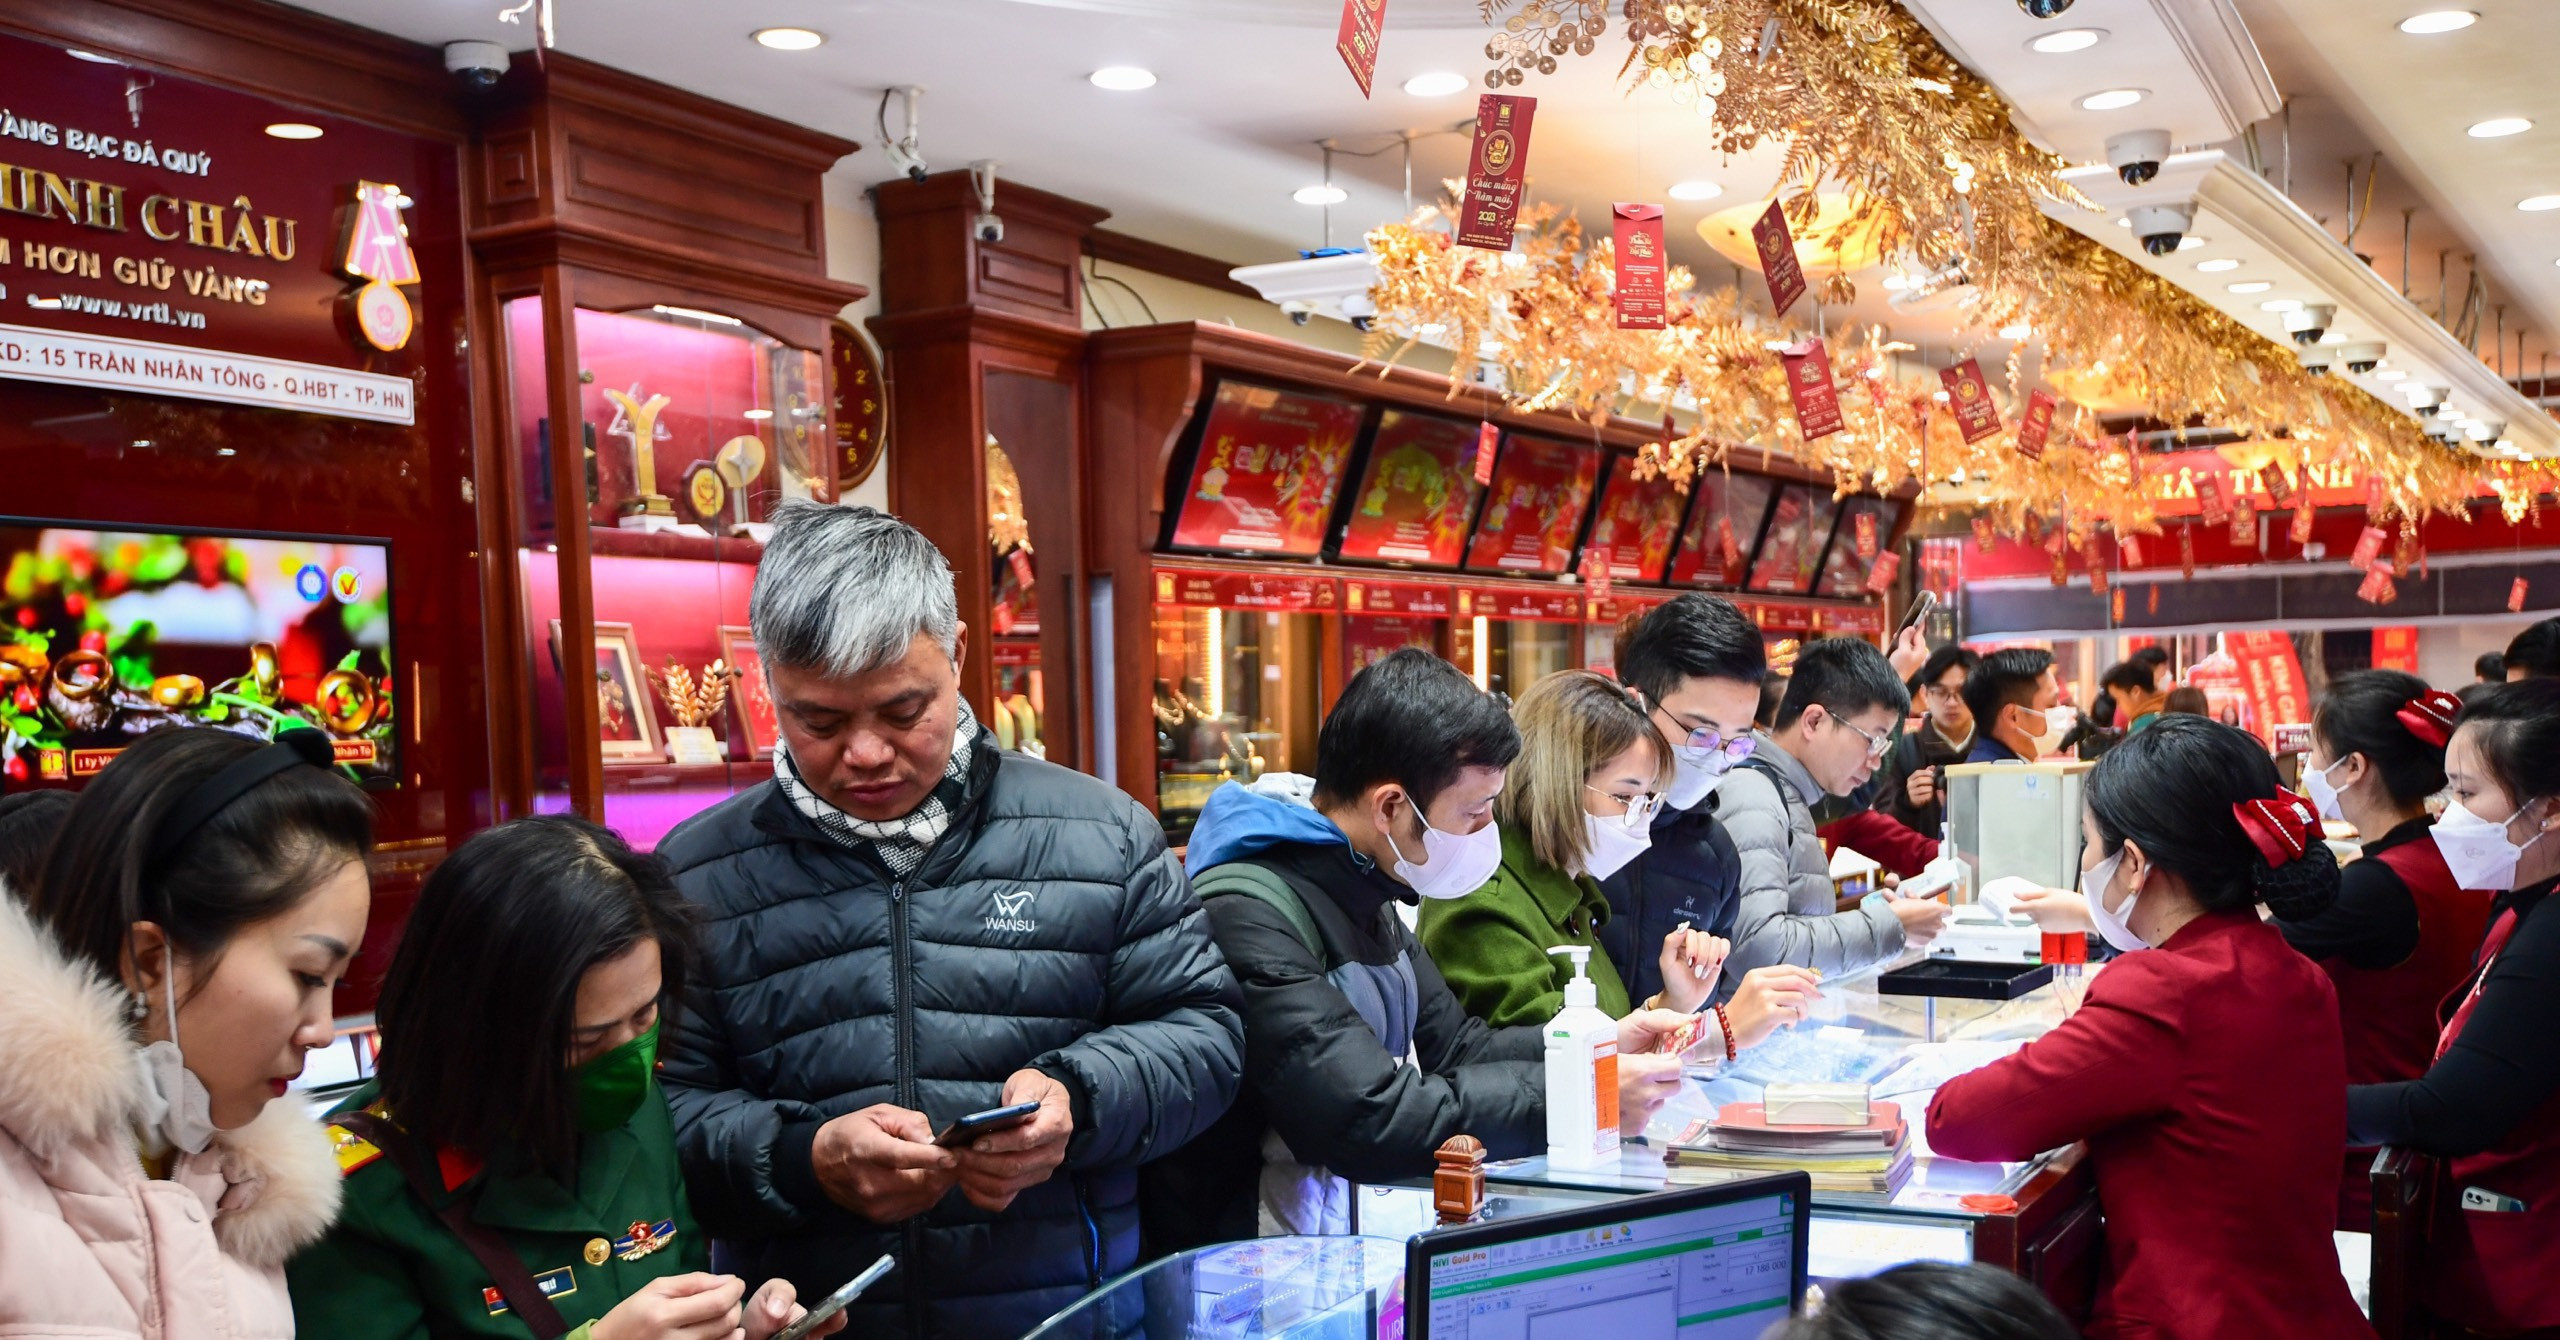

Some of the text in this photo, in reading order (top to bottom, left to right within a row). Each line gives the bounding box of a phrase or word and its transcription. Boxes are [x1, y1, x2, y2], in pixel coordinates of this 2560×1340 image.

[66, 128, 119, 159] BẠC
[123, 139, 160, 167] ĐÁ
[162, 149, 211, 177] QUÝ
[140, 192, 298, 262] CHÂU
[24, 241, 101, 279] HƠN
[113, 257, 175, 290] GIỮ
[183, 265, 270, 306] VÀNG
[41, 347, 66, 366] 15
[144, 359, 203, 382] NHÂN
[211, 365, 266, 390] TÔNG
[284, 377, 338, 400] Q.HBT
[355, 386, 378, 405] TP.
[383, 391, 404, 409] HN
[856, 369, 867, 384] 2
[862, 399, 873, 415] 3
[858, 428, 868, 441] 4
[847, 448, 858, 463] 5
[985, 917, 1035, 932] WANSU
[1432, 1251, 1487, 1268] HiVi Gold Pro
